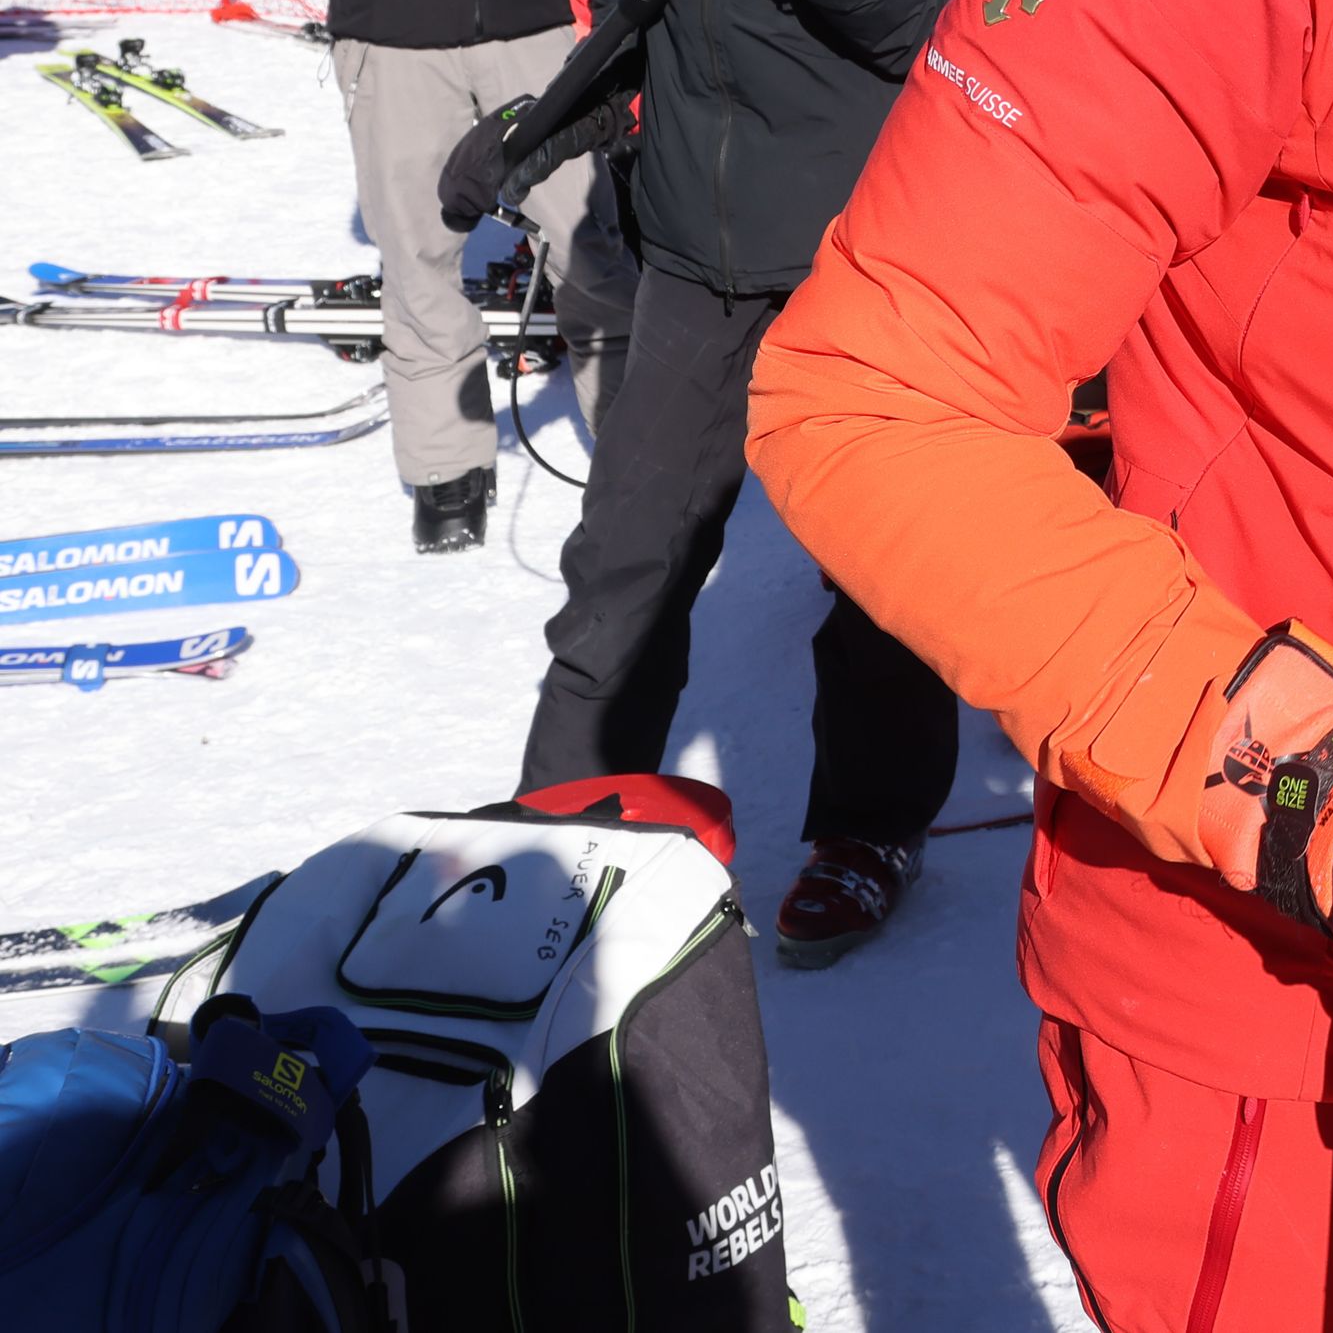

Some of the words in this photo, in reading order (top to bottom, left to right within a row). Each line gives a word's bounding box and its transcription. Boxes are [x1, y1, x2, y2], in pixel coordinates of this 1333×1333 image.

[964, 76, 1023, 128] SUISSE
[0, 570, 184, 612] SALOMON
[1276, 790, 1307, 811] SIZE
[1279, 775, 1309, 794] ONE
[562, 840, 599, 901] AUER
[686, 1164, 778, 1246] WORLD
[688, 1197, 782, 1281] REBELS
